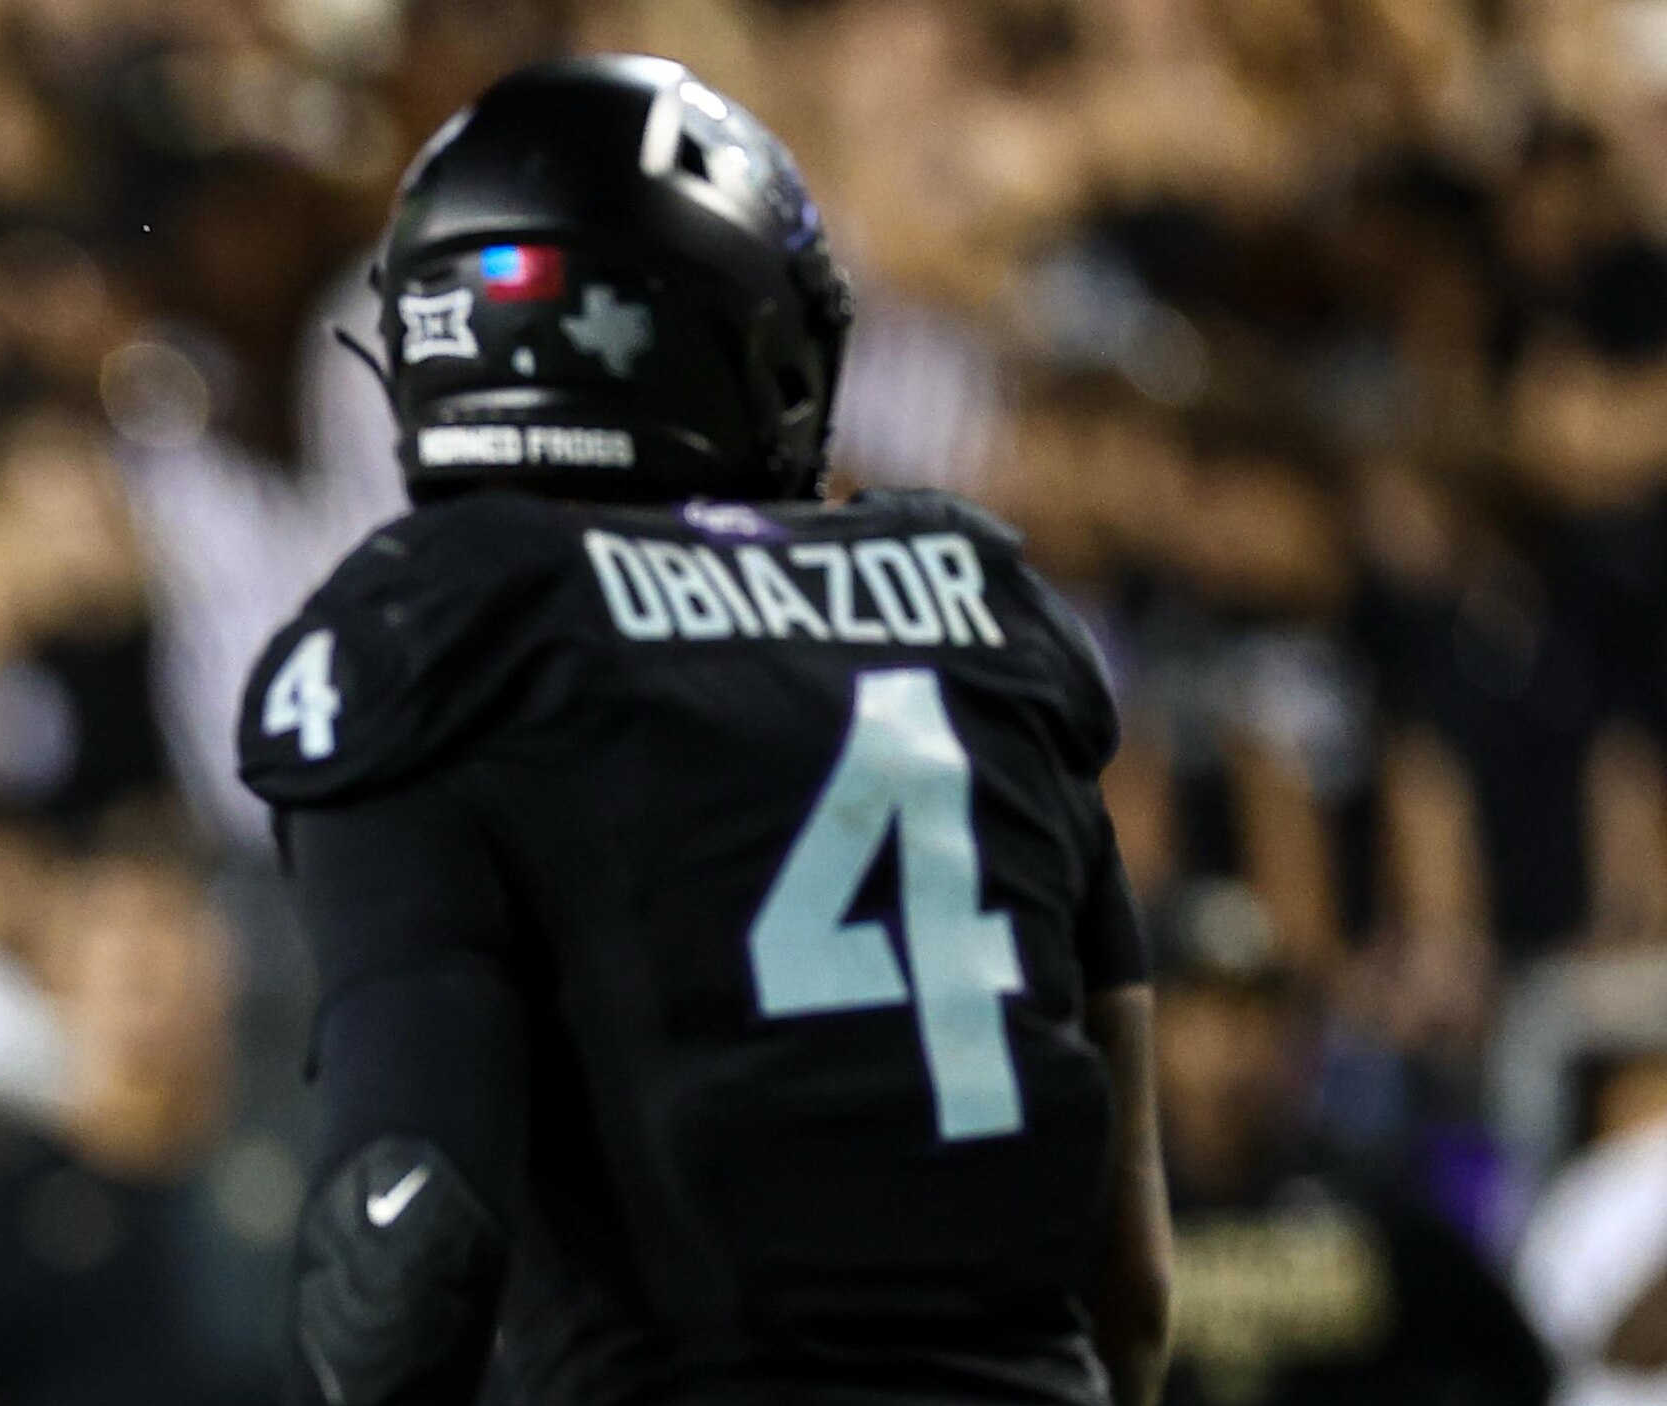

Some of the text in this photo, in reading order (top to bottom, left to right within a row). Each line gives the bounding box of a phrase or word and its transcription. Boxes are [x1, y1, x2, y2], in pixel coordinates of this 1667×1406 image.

[583, 527, 1007, 649] OBIAZOR
[260, 628, 343, 760] 4
[749, 668, 1026, 1143] 4
